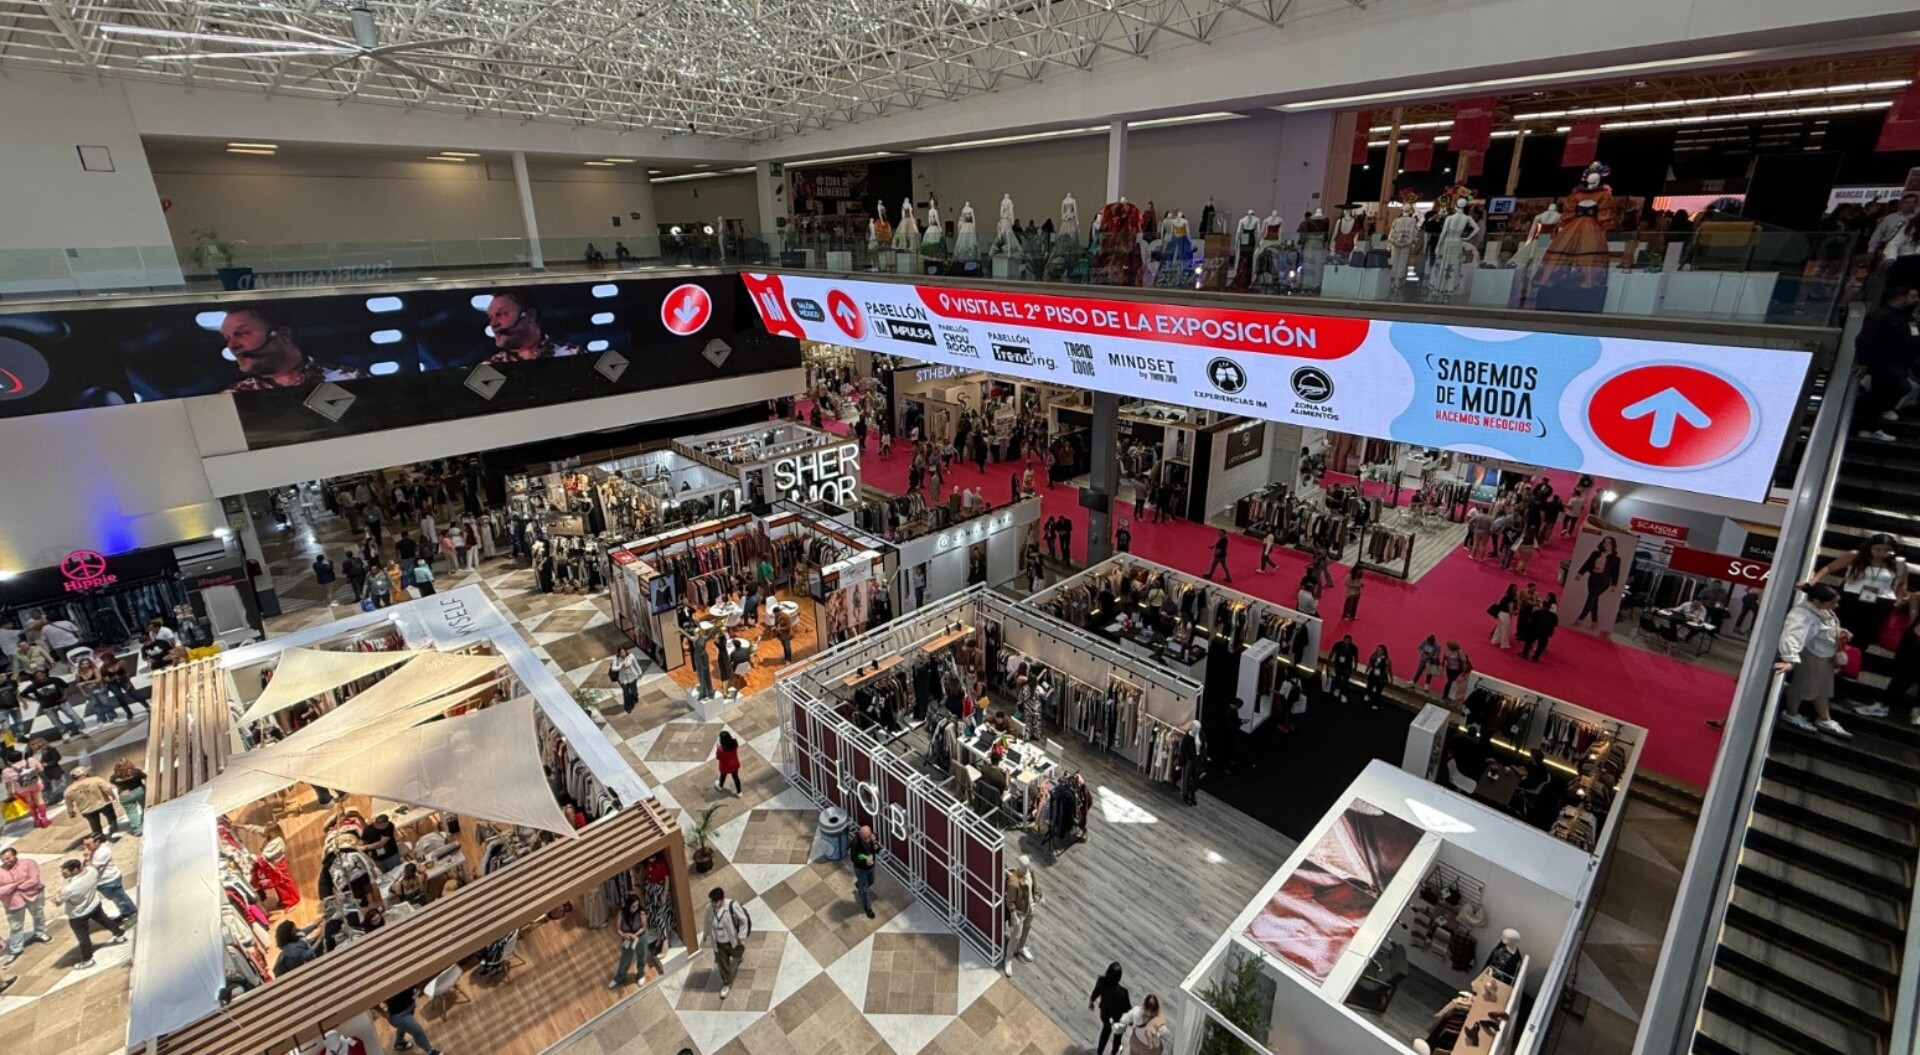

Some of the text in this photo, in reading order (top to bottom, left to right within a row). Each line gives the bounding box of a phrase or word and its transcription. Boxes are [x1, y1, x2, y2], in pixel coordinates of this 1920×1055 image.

[865, 301, 928, 321] PABELLÓN
[938, 323, 970, 334] PABELLÓN
[950, 297, 1001, 317] VISITA
[1002, 301, 1024, 319] EL
[1044, 305, 1089, 326] PISO
[1091, 309, 1121, 329] DE
[1124, 311, 1152, 332] LA
[1155, 314, 1317, 349] EXPOSICIÓN
[944, 333, 970, 344] CHOU
[987, 331, 1031, 345] PABELLÓN
[1108, 352, 1175, 374] MINDSET
[916, 365, 957, 383] STHELA
[1139, 371, 1148, 380] by
[1437, 357, 1538, 391] SABEMOS
[1194, 390, 1268, 409] EXPERIENCIAS IM
[1294, 402, 1318, 411] ZONA
[1436, 385, 1533, 420] DE MODA
[1291, 408, 1340, 421] ALIMENTOS
[1435, 409, 1533, 433] HACEMOS NEGOCIOS
[775, 444, 860, 490] SHER
[63, 573, 118, 592] Hippie
[440, 597, 481, 637] MYSELF
[836, 759, 907, 841] LOB
